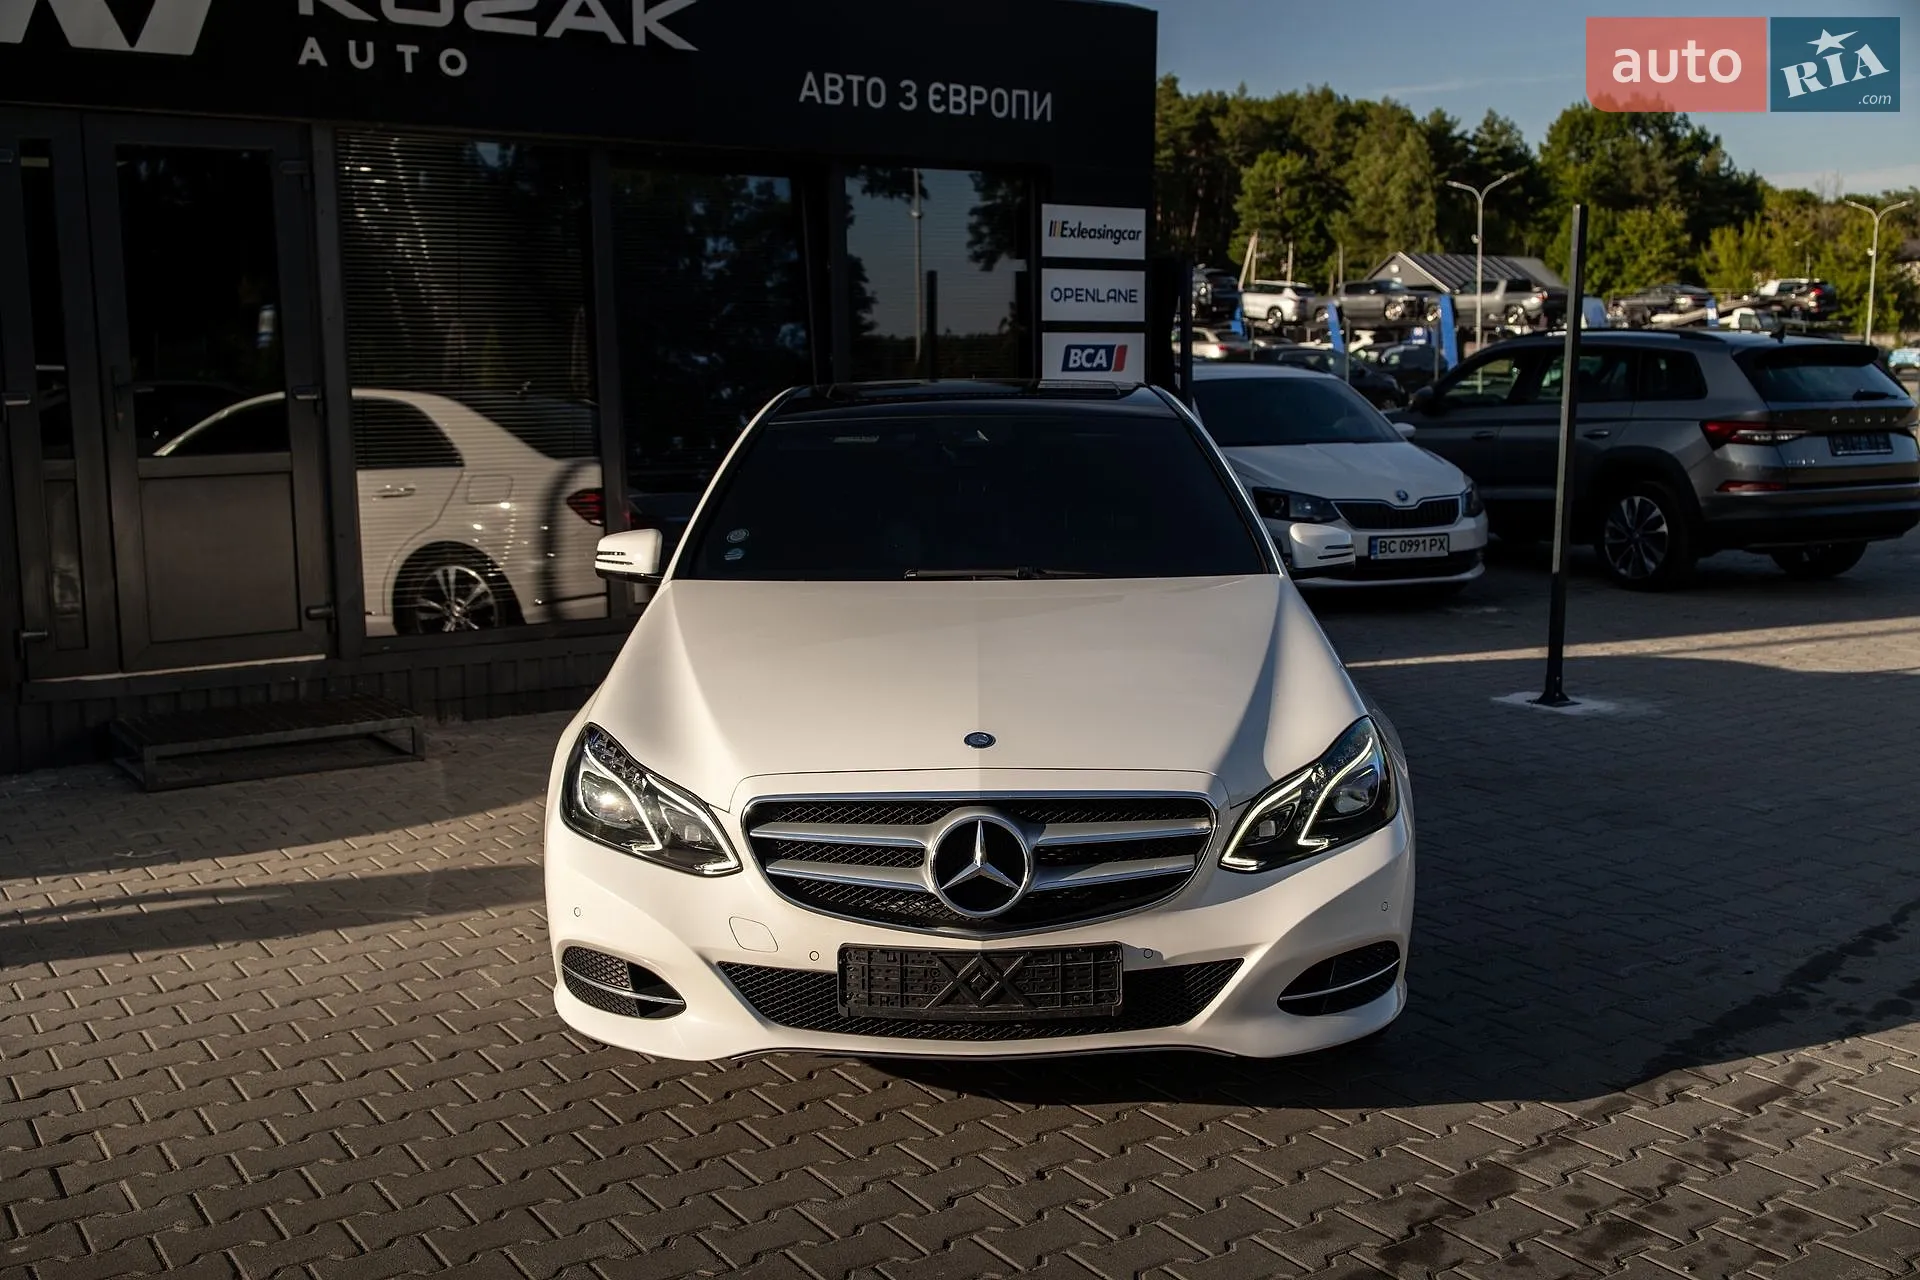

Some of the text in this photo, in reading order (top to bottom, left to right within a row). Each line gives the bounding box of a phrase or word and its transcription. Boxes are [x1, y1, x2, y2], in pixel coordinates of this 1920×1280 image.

[298, 36, 468, 77] AUTO
[798, 71, 886, 109] АВТО
[928, 82, 1053, 122] ЄВРОПИ
[1060, 220, 1143, 245] Exleasingcar
[1050, 286, 1138, 303] OPENLANE
[1068, 348, 1108, 369] BCA
[1379, 537, 1446, 554] BC 0991 PX
